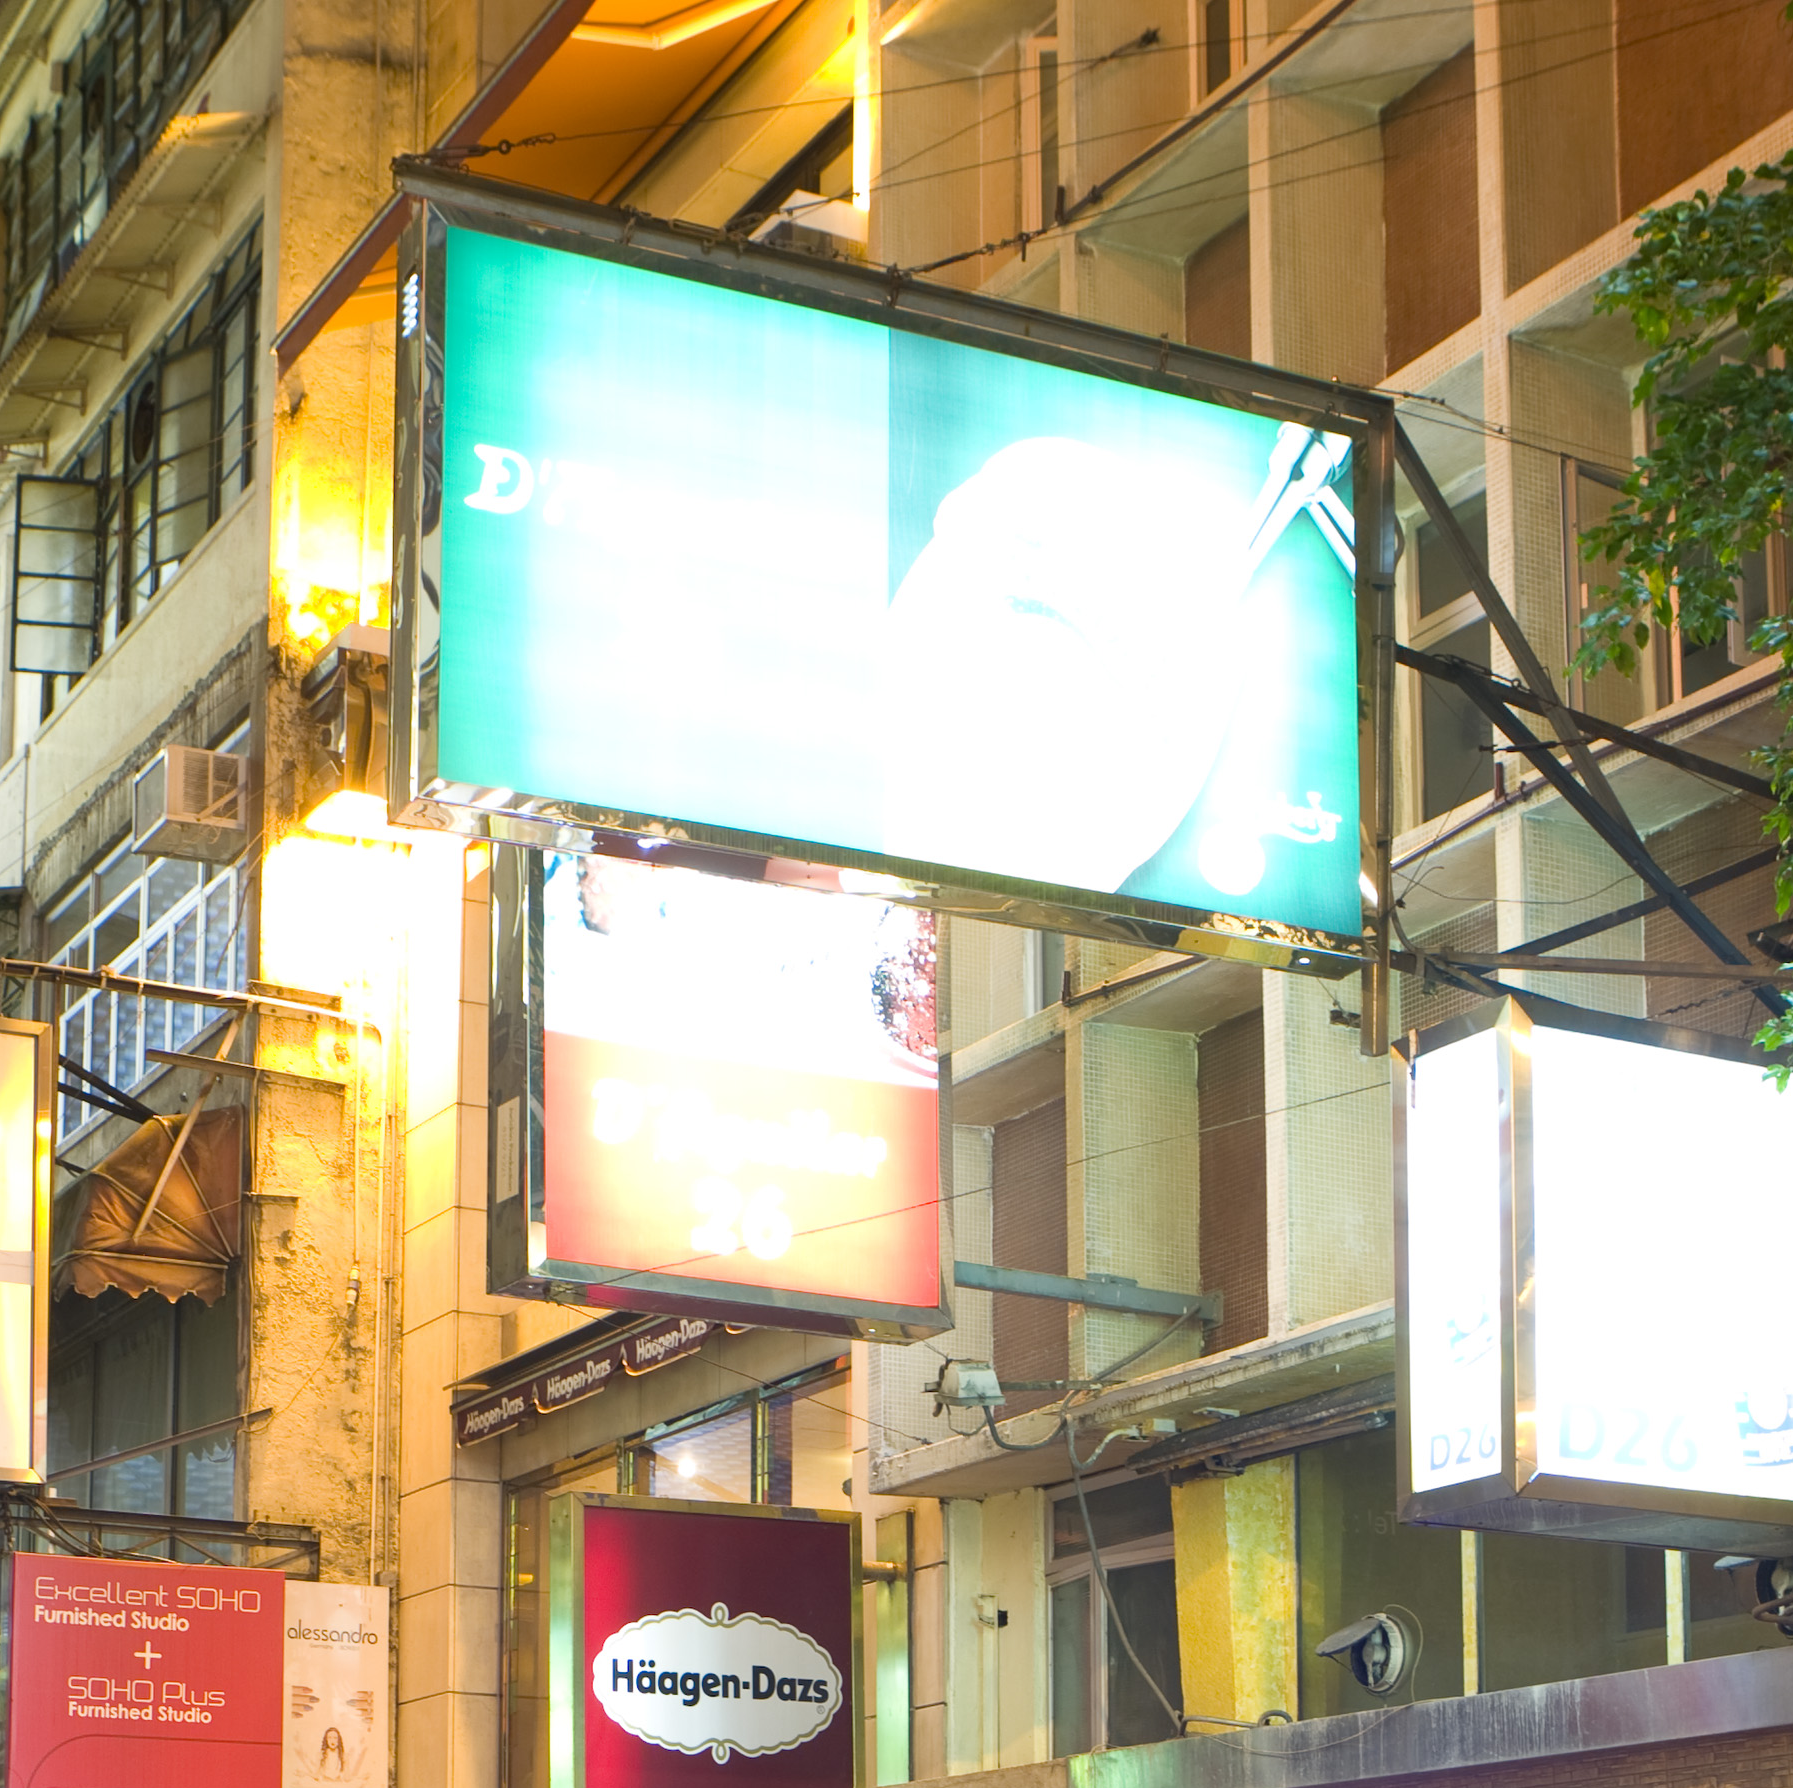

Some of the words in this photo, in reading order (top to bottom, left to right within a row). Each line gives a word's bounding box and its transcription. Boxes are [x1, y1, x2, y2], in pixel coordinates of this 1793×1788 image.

[1429, 1424, 1497, 1472] D26
[1557, 1402, 1699, 1473] D26
[34, 1576, 169, 1608] Excellent
[176, 1585, 261, 1613] SOHO
[34, 1604, 126, 1629] Furnished
[130, 1611, 190, 1632] Studio
[287, 1619, 378, 1645] alessandro
[68, 1676, 154, 1703] SOHO
[162, 1681, 225, 1707] Plus
[612, 1658, 829, 1706] Häagen-Dazs
[68, 1701, 153, 1721] Furnished
[158, 1706, 212, 1724] Studio
